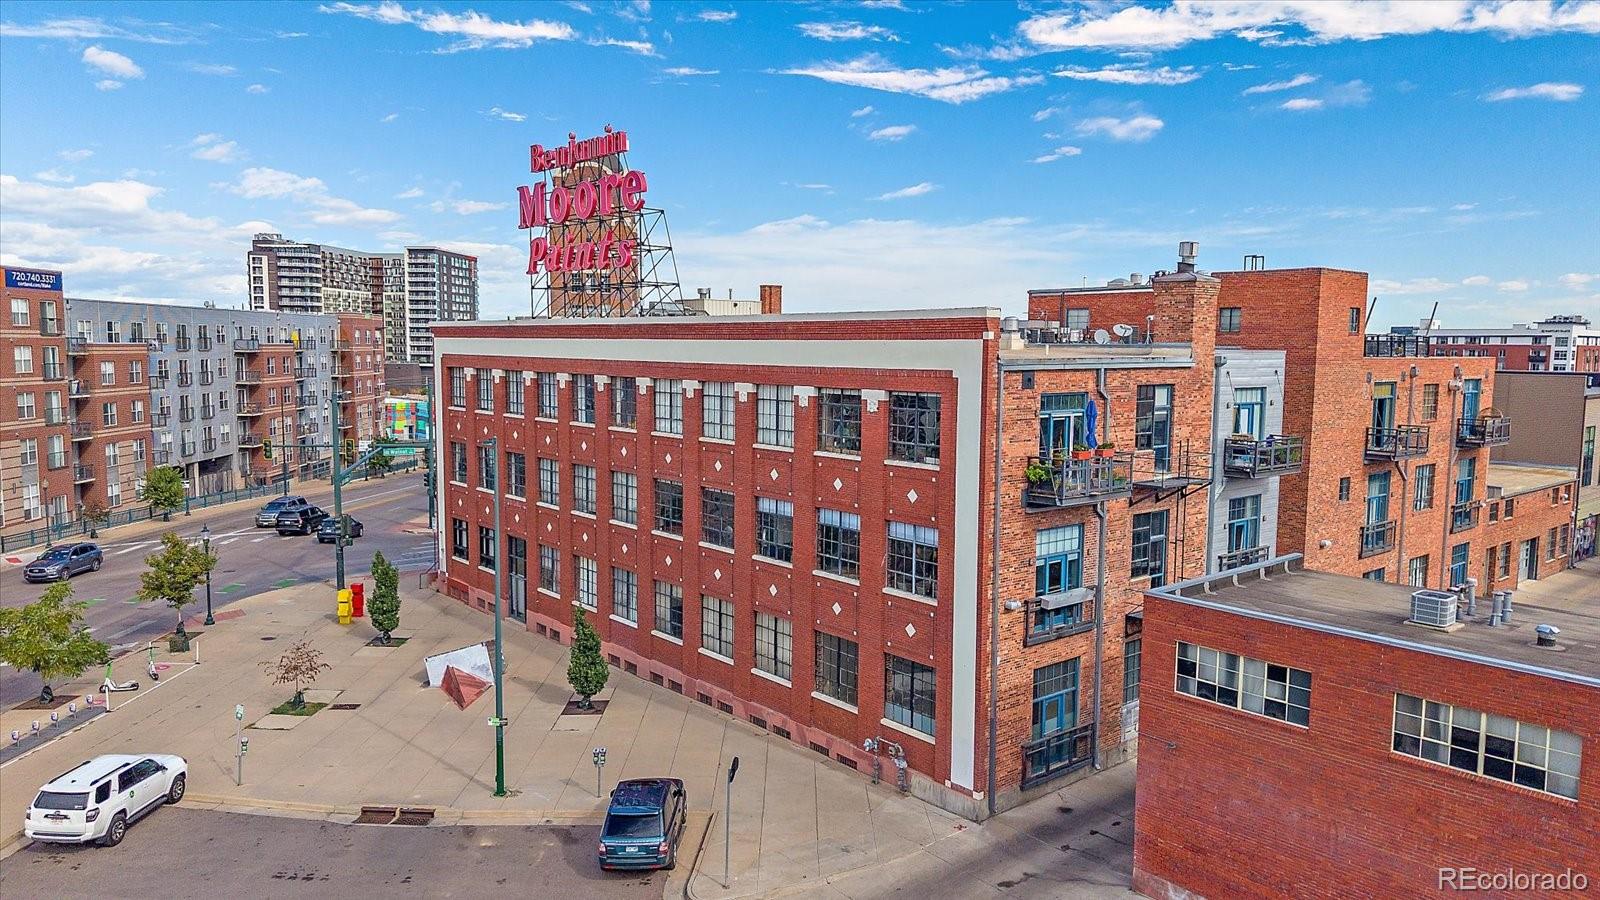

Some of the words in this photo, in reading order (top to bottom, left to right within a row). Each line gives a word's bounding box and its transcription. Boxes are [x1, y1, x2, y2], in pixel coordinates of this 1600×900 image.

[530, 123, 629, 173] Benjamin
[517, 170, 647, 229] Moore
[526, 230, 635, 275] Paints
[11, 271, 56, 283] 720.740.3331
